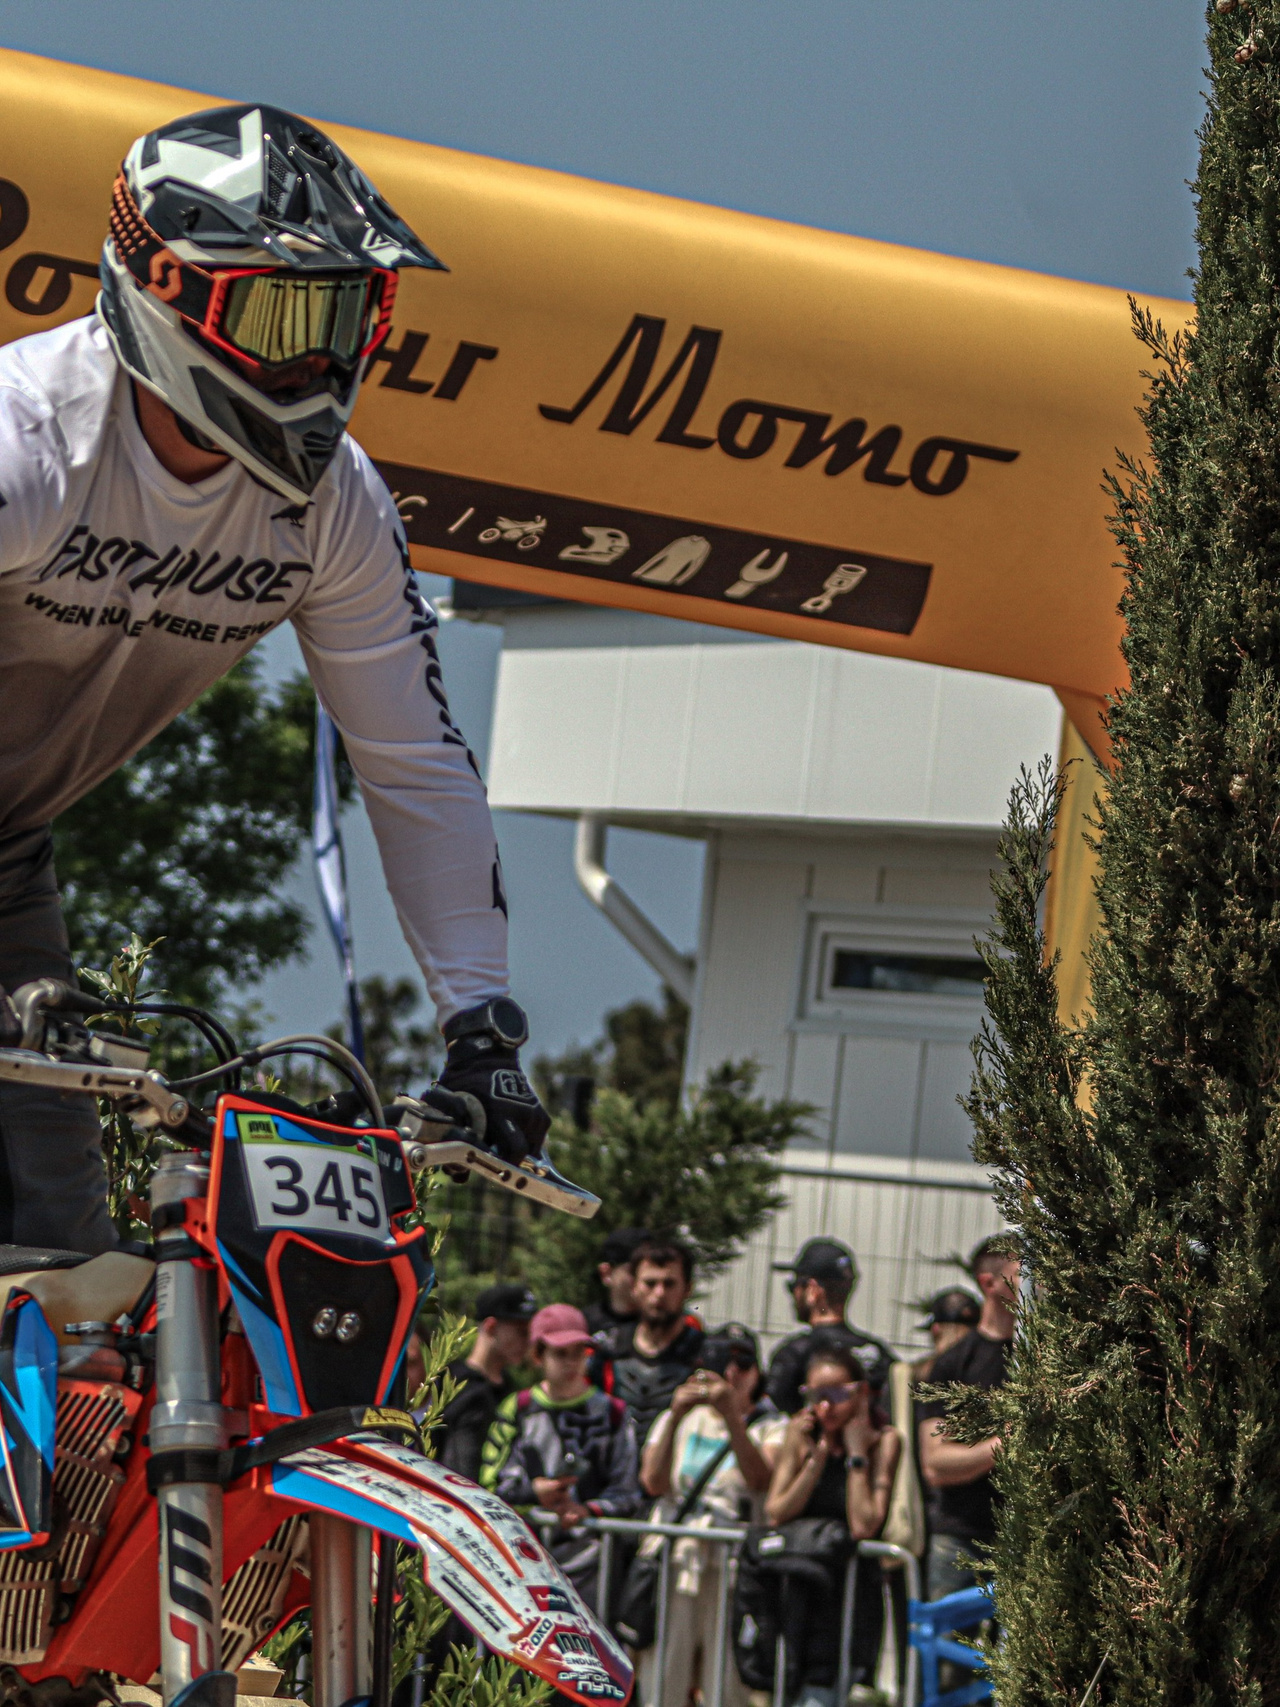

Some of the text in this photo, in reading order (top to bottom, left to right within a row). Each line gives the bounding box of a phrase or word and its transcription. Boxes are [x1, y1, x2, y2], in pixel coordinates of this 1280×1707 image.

[24, 592, 95, 627] WHEN
[263, 1155, 382, 1229] 345
[566, 1656, 604, 1668] ENDURO
[577, 1680, 626, 1699] ПУТЬ
